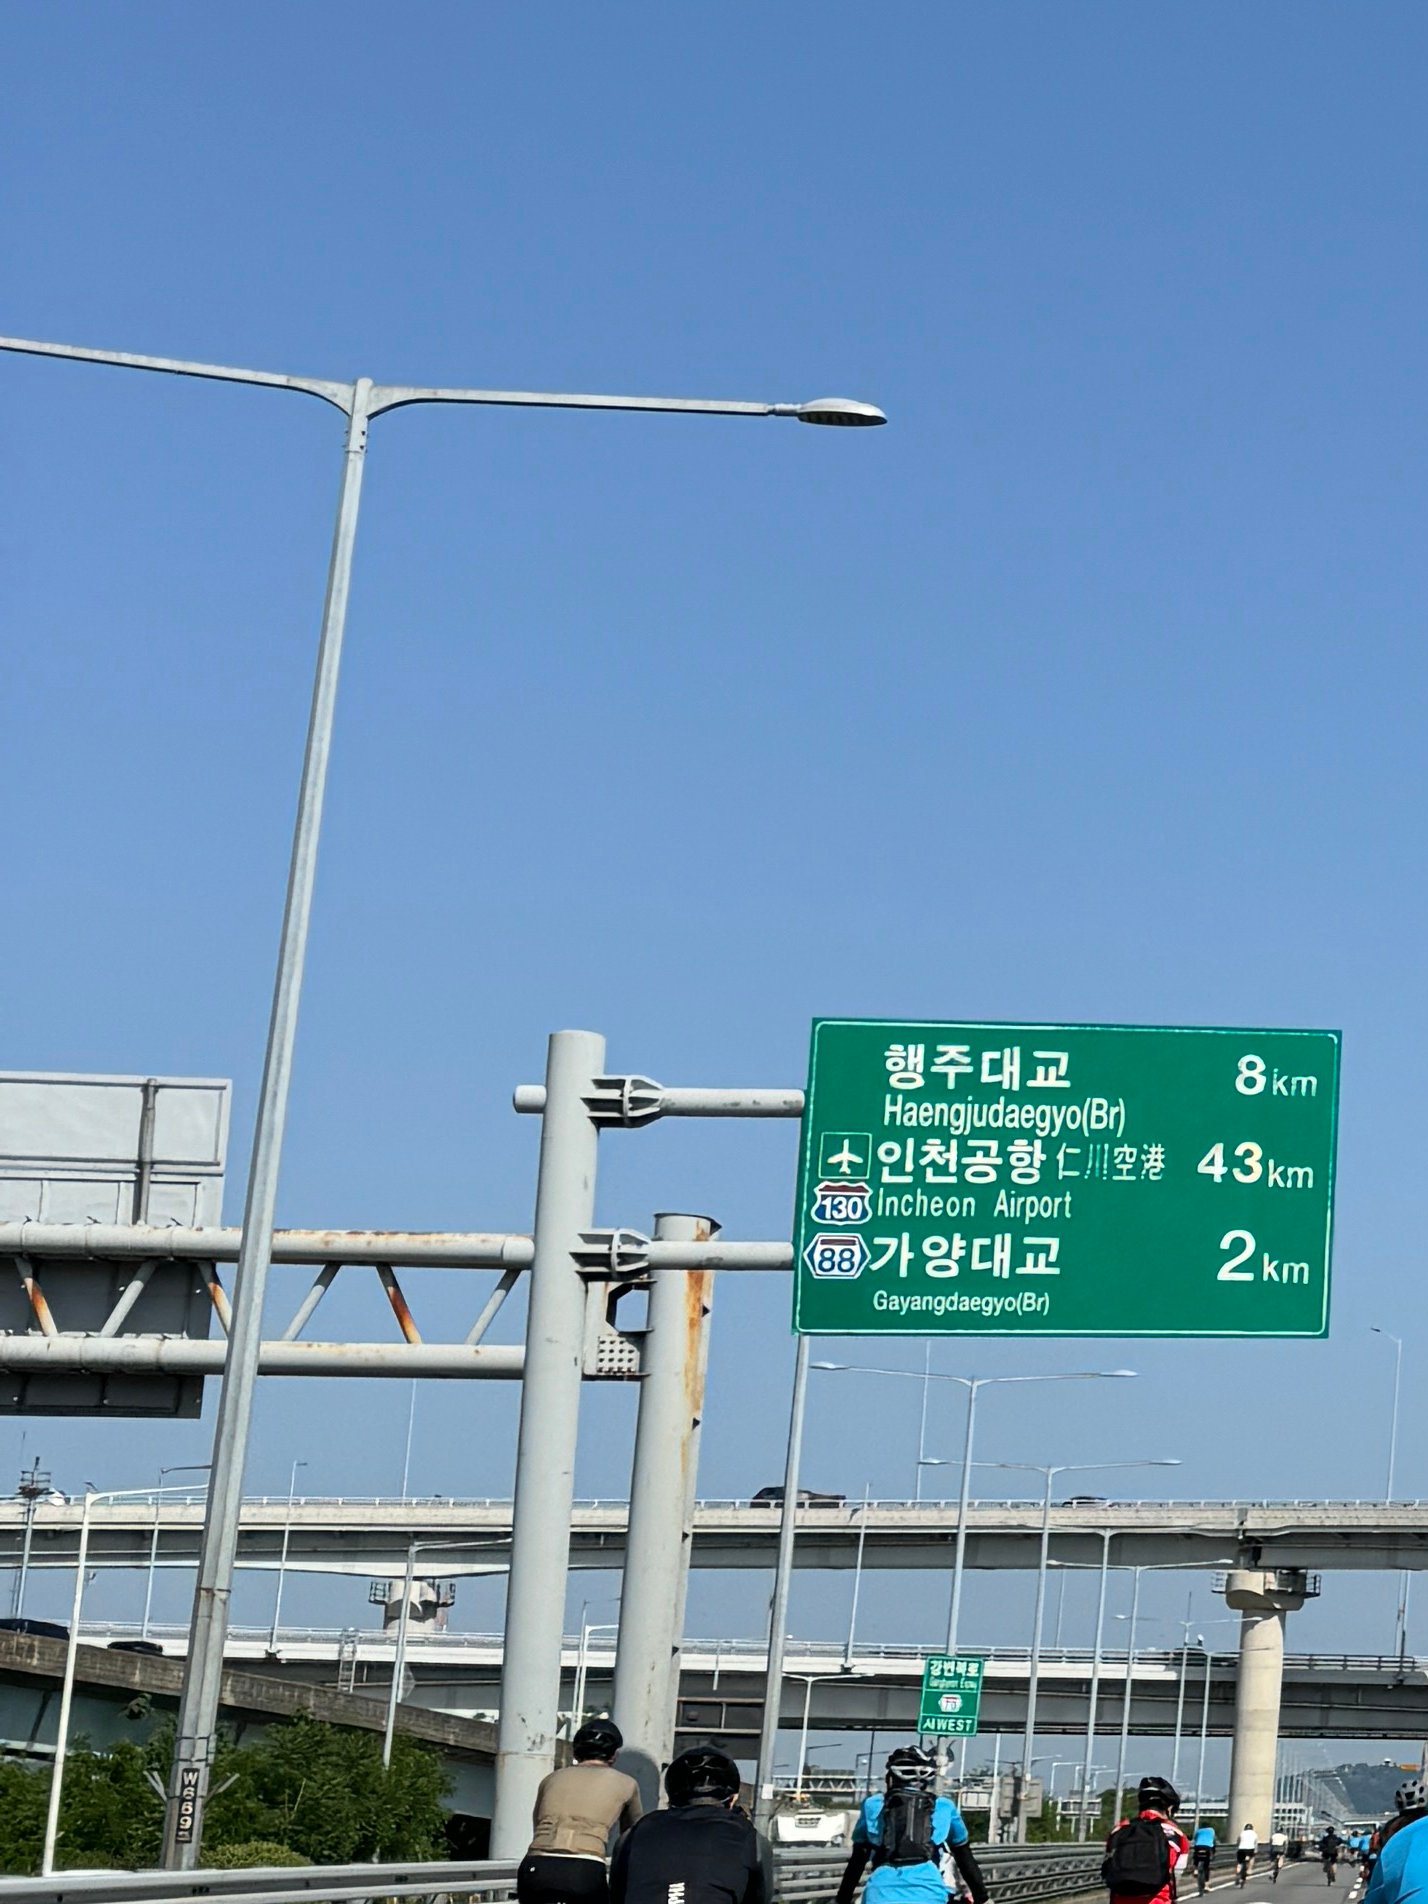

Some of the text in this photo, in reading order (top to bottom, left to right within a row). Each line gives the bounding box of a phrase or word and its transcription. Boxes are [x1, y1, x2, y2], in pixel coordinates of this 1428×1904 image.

[884, 1043, 1071, 1091] 행주대교
[883, 1094, 1126, 1138] Haengjudaegyo(Br)
[876, 1137, 1047, 1185] 인천공항
[1056, 1142, 1166, 1181] 仁川空港
[821, 1196, 863, 1221] 130
[877, 1187, 1073, 1225] Incheon Airport
[817, 1247, 856, 1273] 88
[868, 1232, 1061, 1279] 가양대교
[873, 1290, 1050, 1316] Gayangdaegyo(Br)
